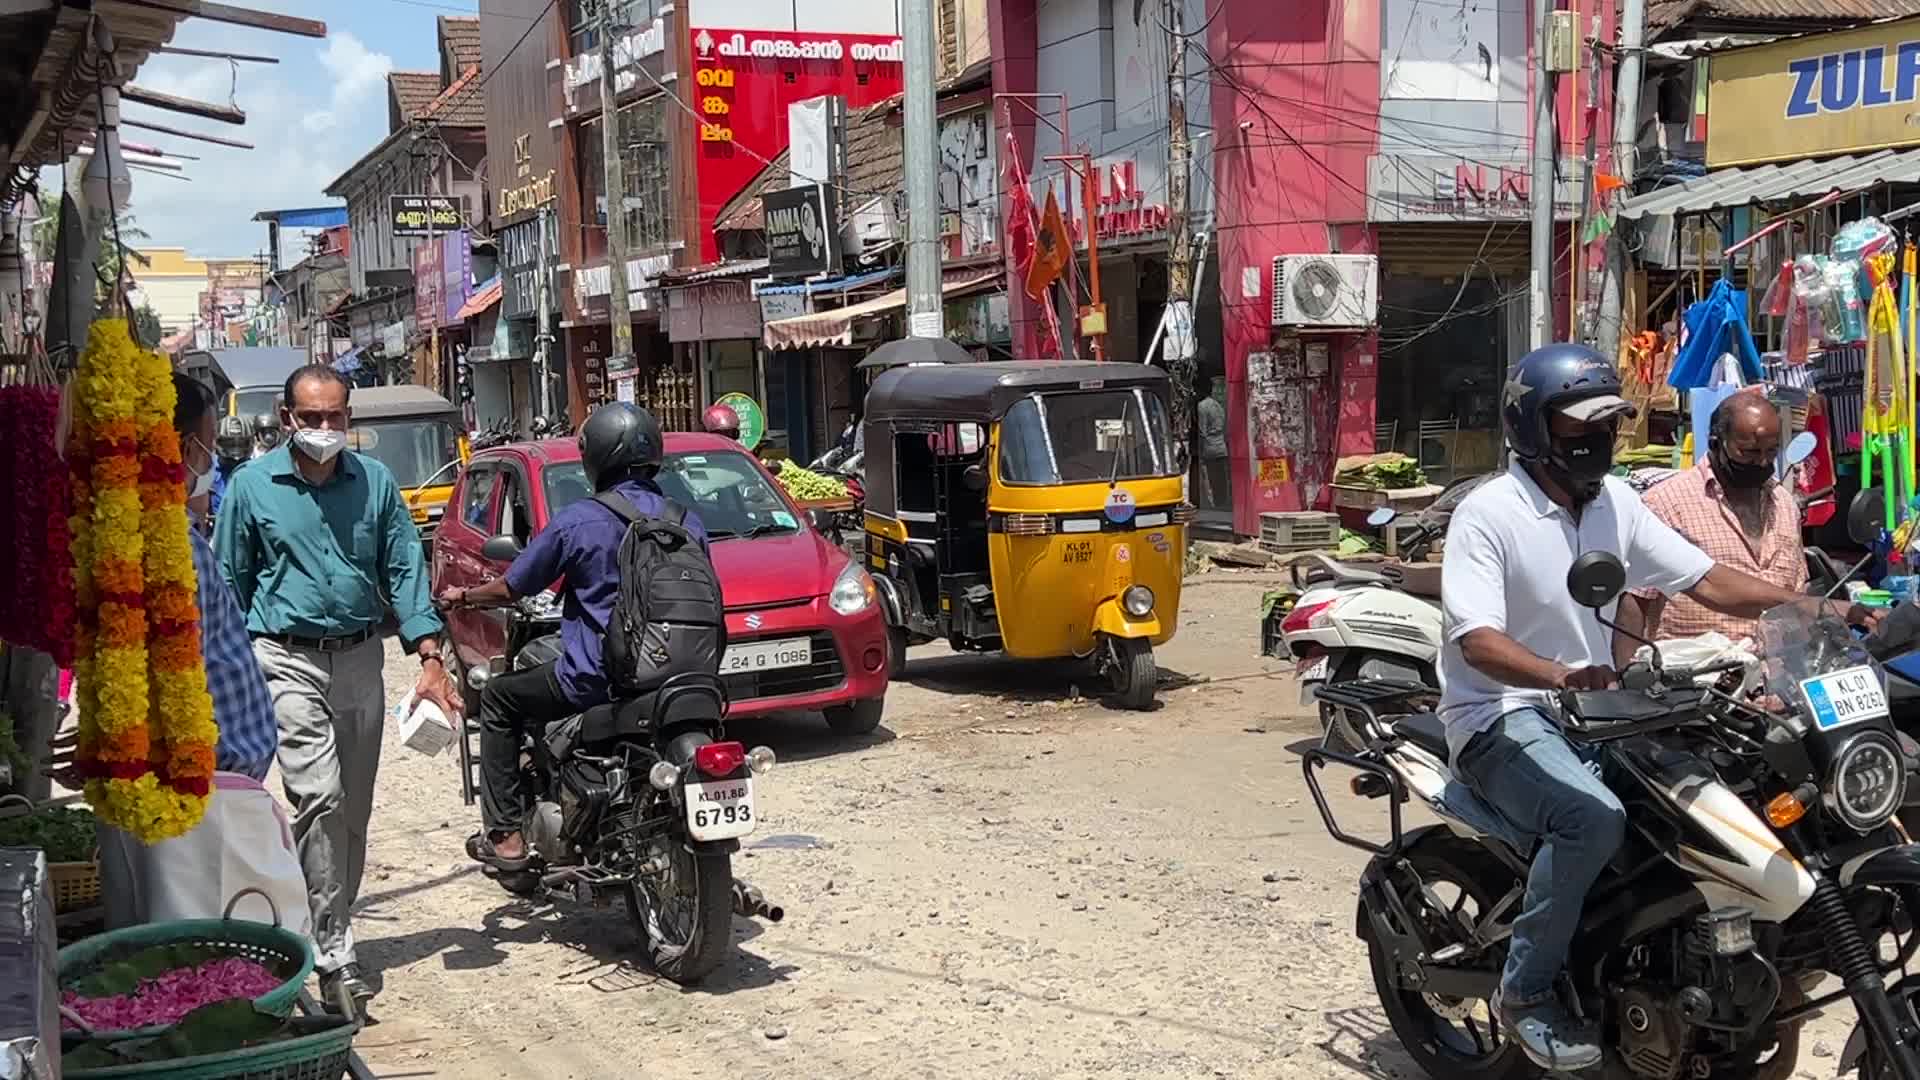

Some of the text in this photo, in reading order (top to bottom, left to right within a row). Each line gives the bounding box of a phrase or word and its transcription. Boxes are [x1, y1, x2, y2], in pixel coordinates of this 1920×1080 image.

[767, 207, 801, 236] AMMA
[1112, 494, 1127, 504] TC
[731, 656, 749, 669] 24
[774, 649, 809, 664] 1086
[1836, 674, 1869, 695] KL 01
[1834, 691, 1884, 716] BN 8262
[695, 804, 751, 827] 6793
